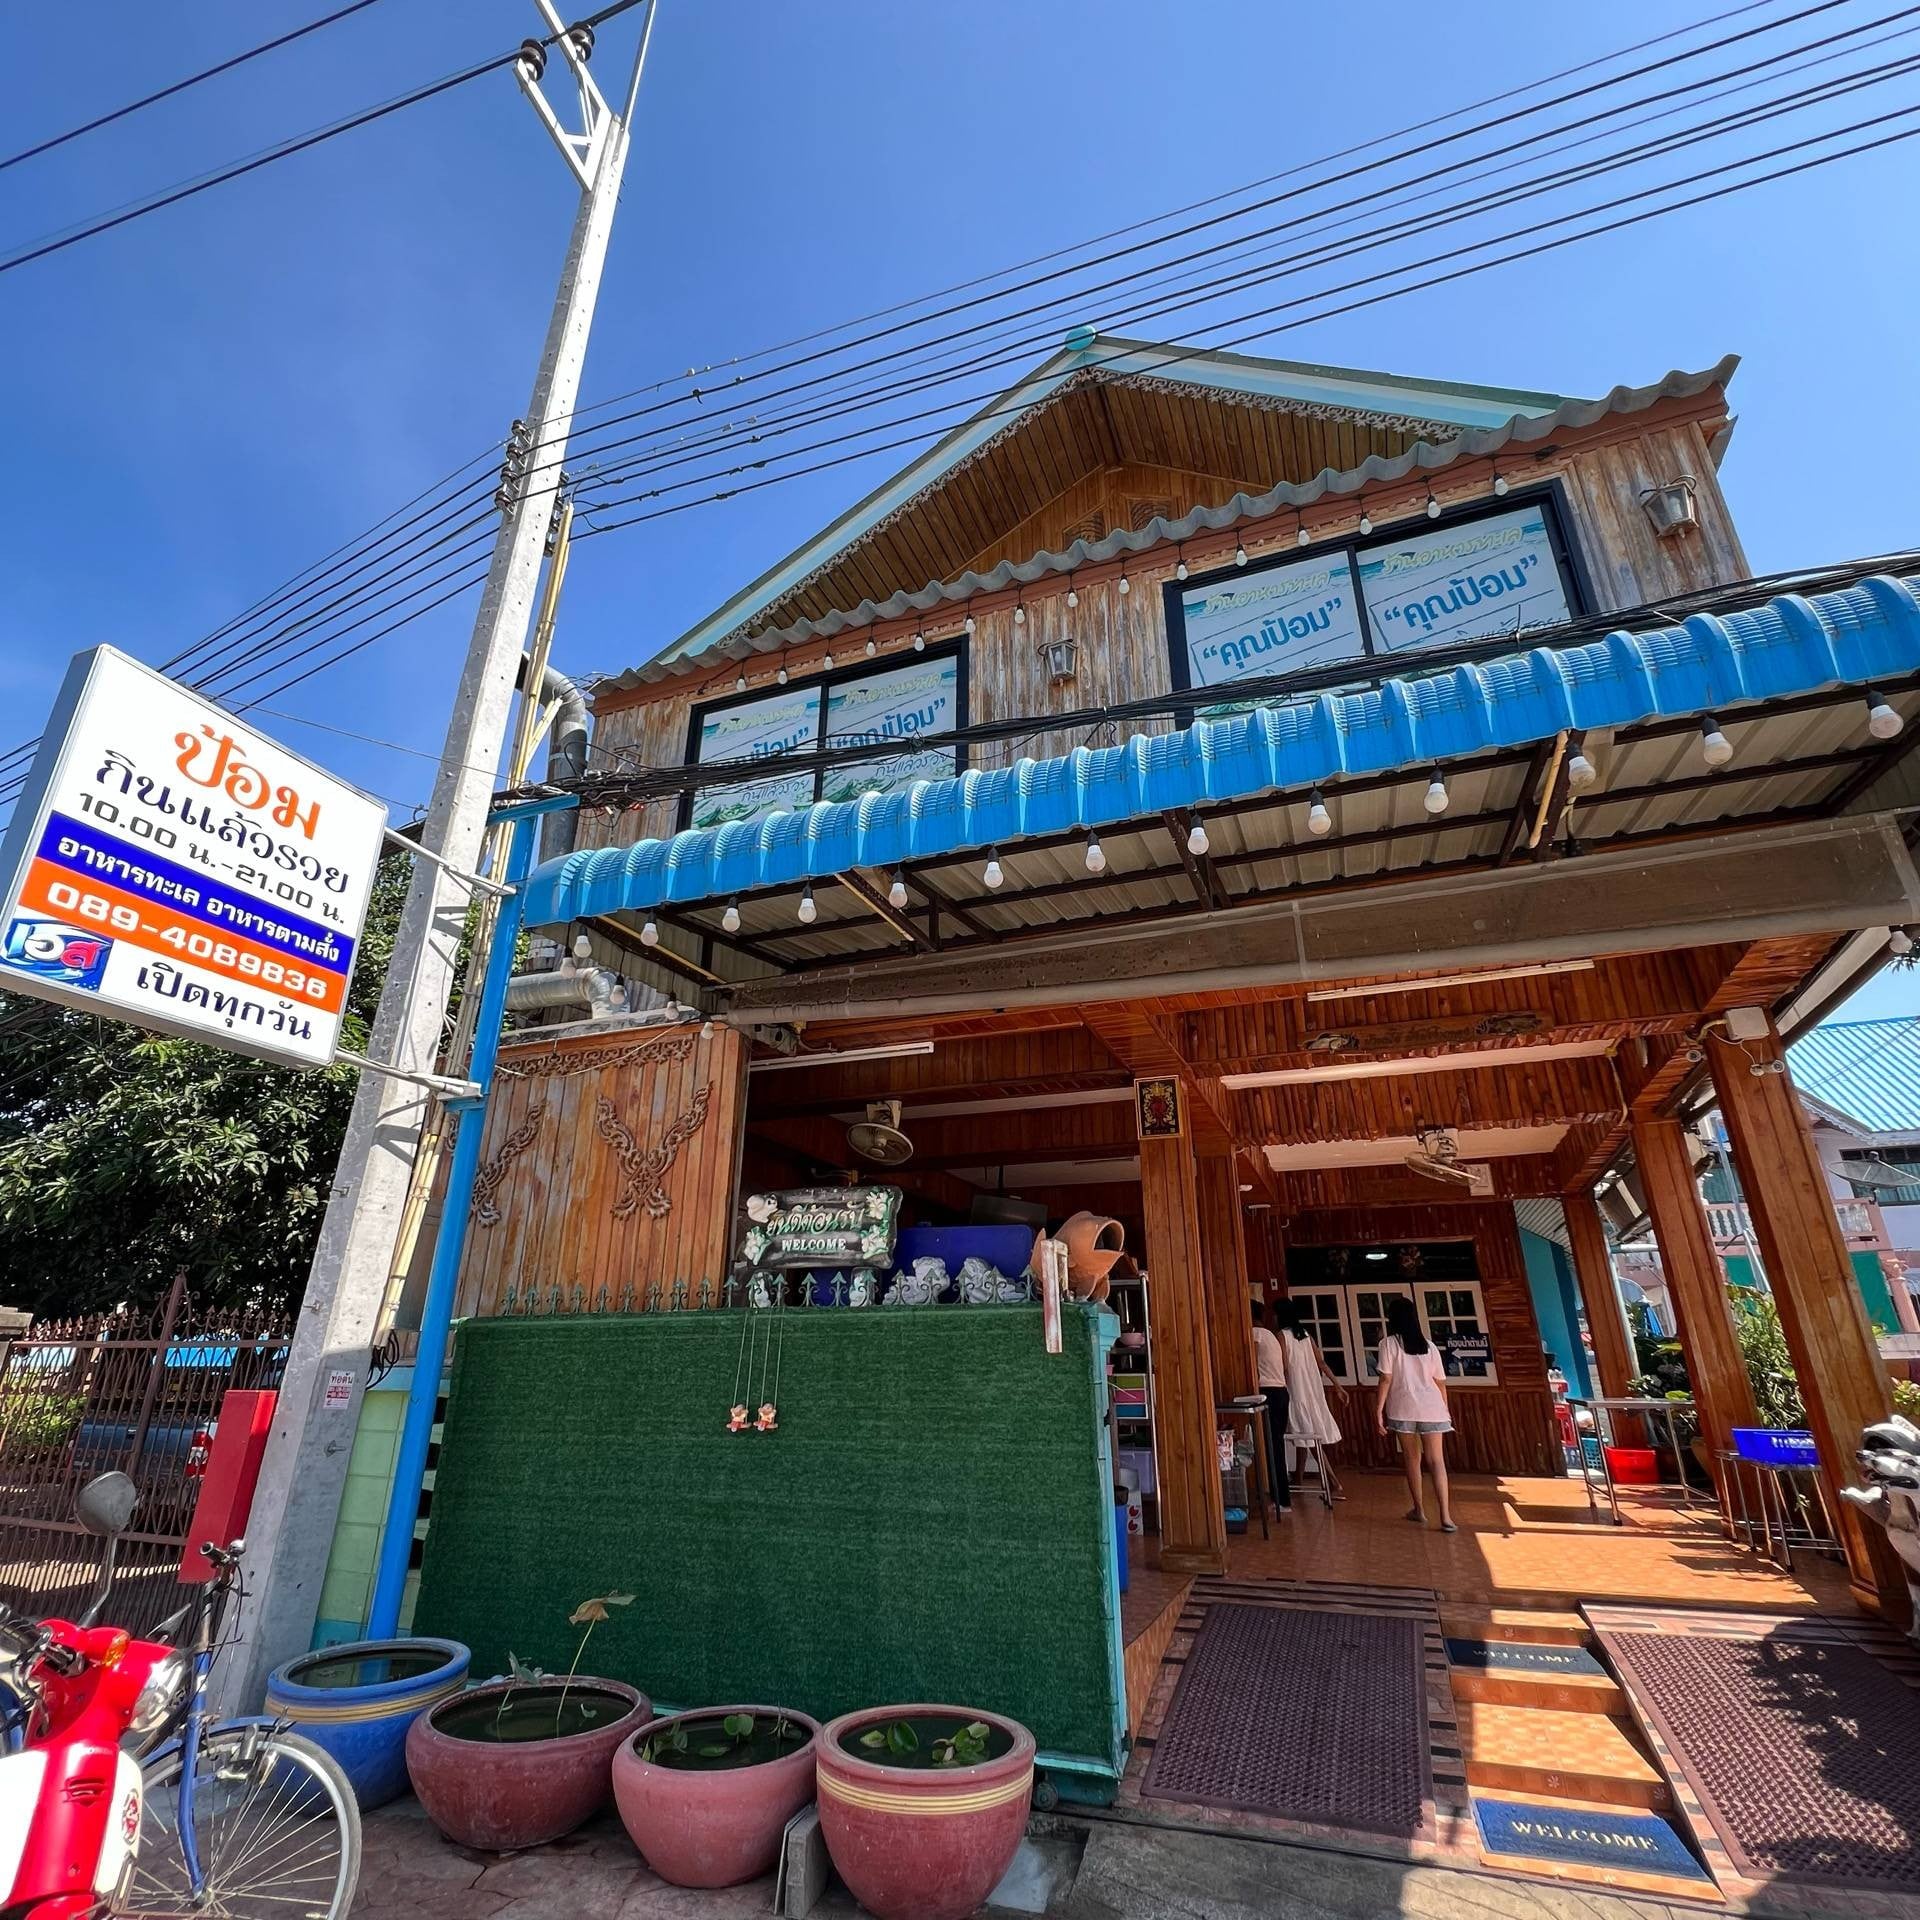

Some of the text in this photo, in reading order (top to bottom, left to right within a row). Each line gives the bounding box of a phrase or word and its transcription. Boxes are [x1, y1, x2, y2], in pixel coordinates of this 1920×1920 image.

[1384, 554, 1538, 631] “คุณป้อม”
[1203, 597, 1342, 669] “คุณป้อม”
[836, 697, 946, 748] “คณป้อม”
[174, 723, 321, 840] ป้อม
[79, 791, 178, 849] 10.00
[322, 902, 344, 924] น.
[97, 749, 349, 893] กินแล้วรวย
[59, 836, 339, 962] อาหารทะเล อาหารตามสั่ง
[47, 881, 328, 999] 089-4089836
[136, 962, 312, 1040] เปิดทุกวัน
[782, 1238, 847, 1251] WELCOME
[1511, 1820, 1659, 1851] WELCOME
